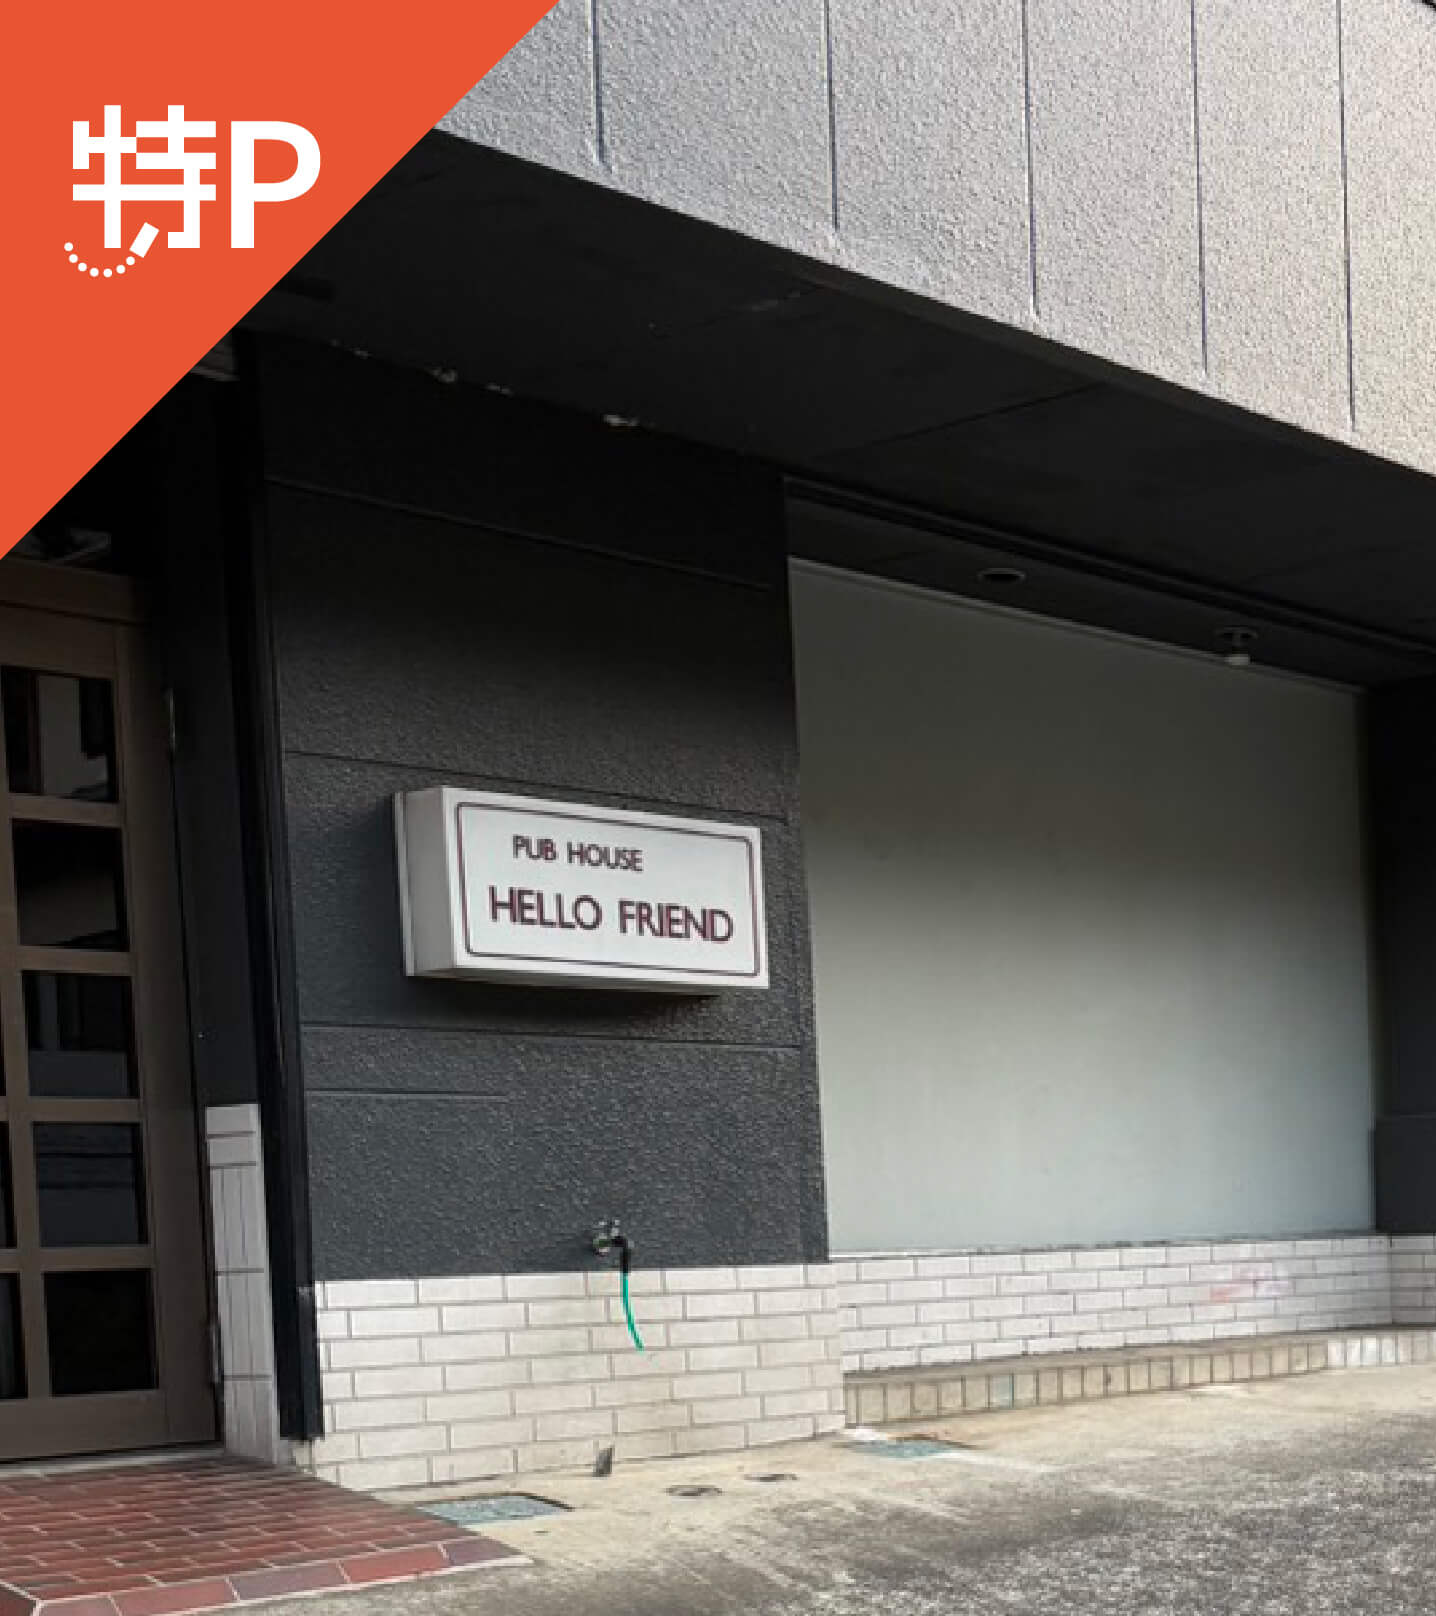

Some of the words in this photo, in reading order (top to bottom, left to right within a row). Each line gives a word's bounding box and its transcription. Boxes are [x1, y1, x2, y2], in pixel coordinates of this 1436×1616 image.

[512, 834, 558, 861] PUB
[566, 841, 645, 873] HOUSE
[488, 885, 603, 931] HELLO
[618, 899, 735, 944] FRIEND
